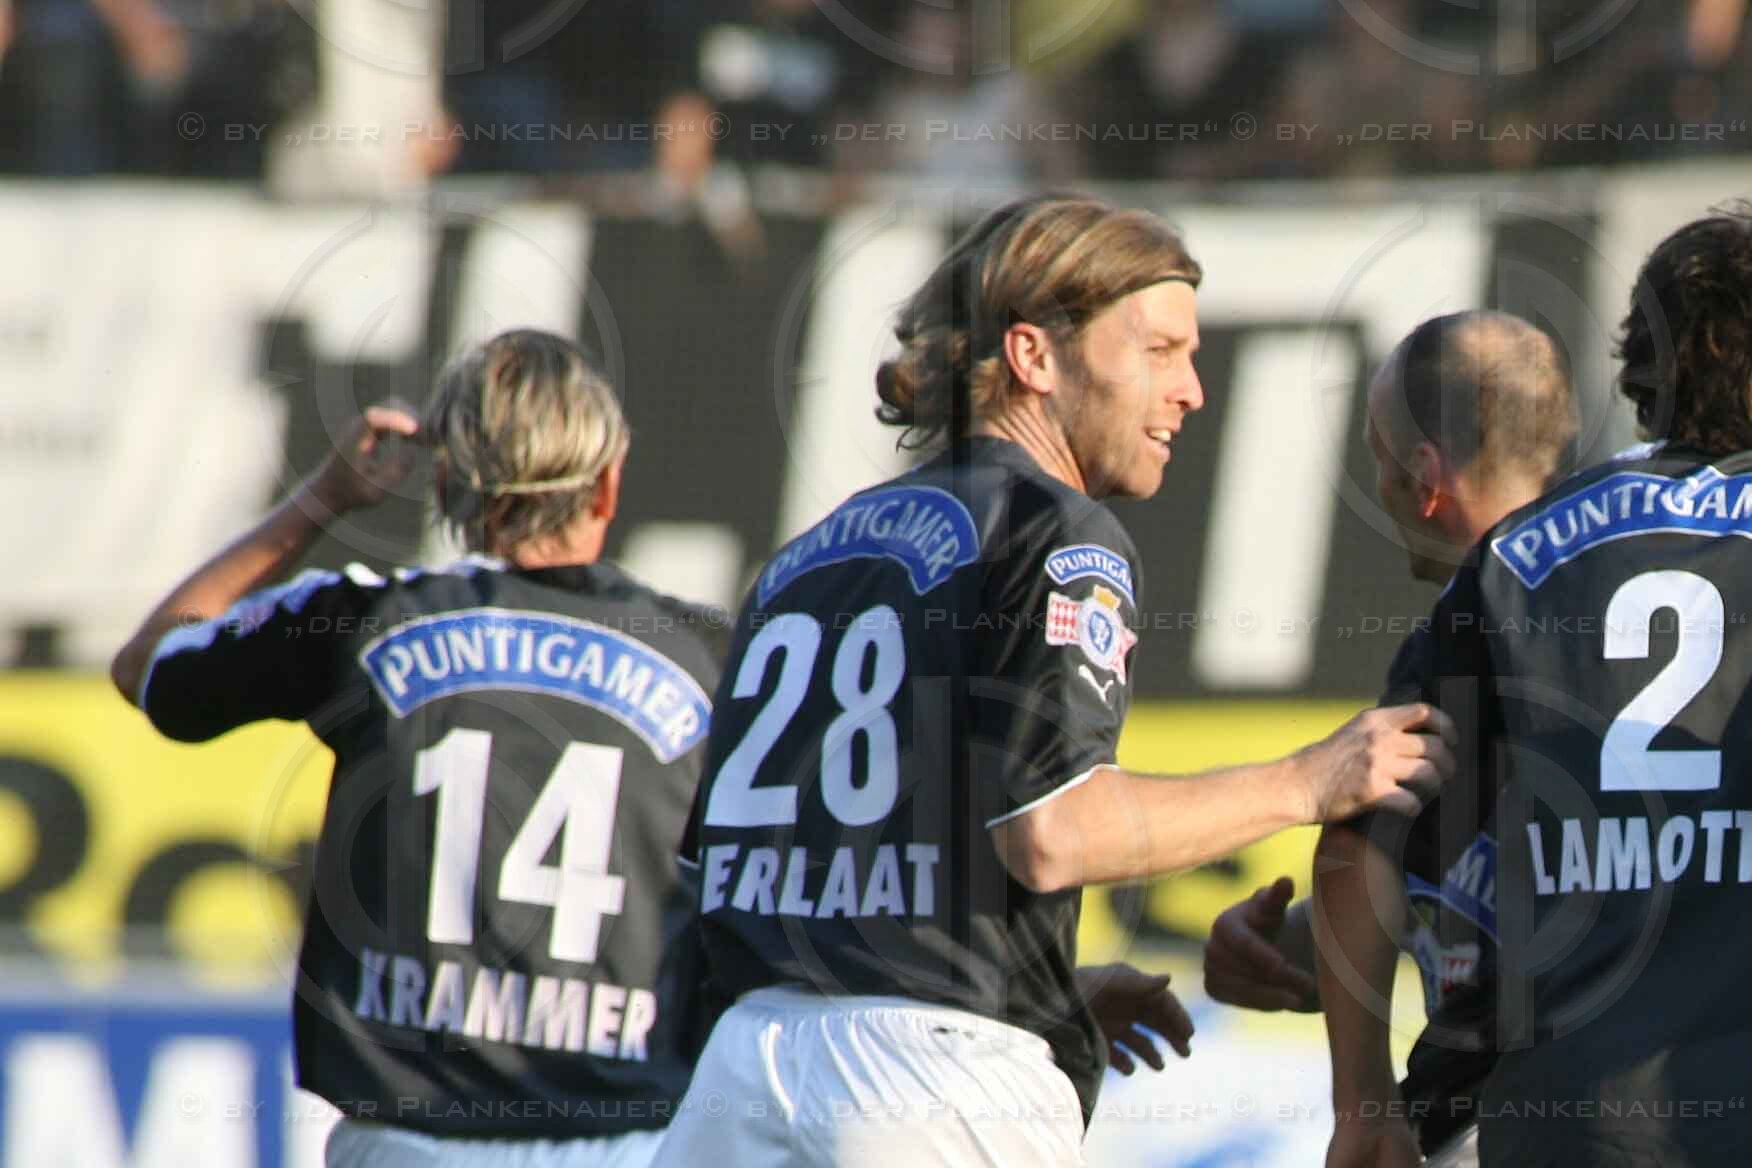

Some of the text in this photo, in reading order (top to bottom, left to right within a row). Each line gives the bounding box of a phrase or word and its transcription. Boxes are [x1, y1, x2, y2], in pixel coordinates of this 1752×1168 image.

[381, 624, 700, 749] PUNTIGAMER
[703, 604, 905, 828] 28
[1600, 569, 1726, 791] 2
[412, 727, 627, 964] 14
[699, 843, 940, 919] ERLAAT
[354, 946, 658, 1062] KRAMMER
